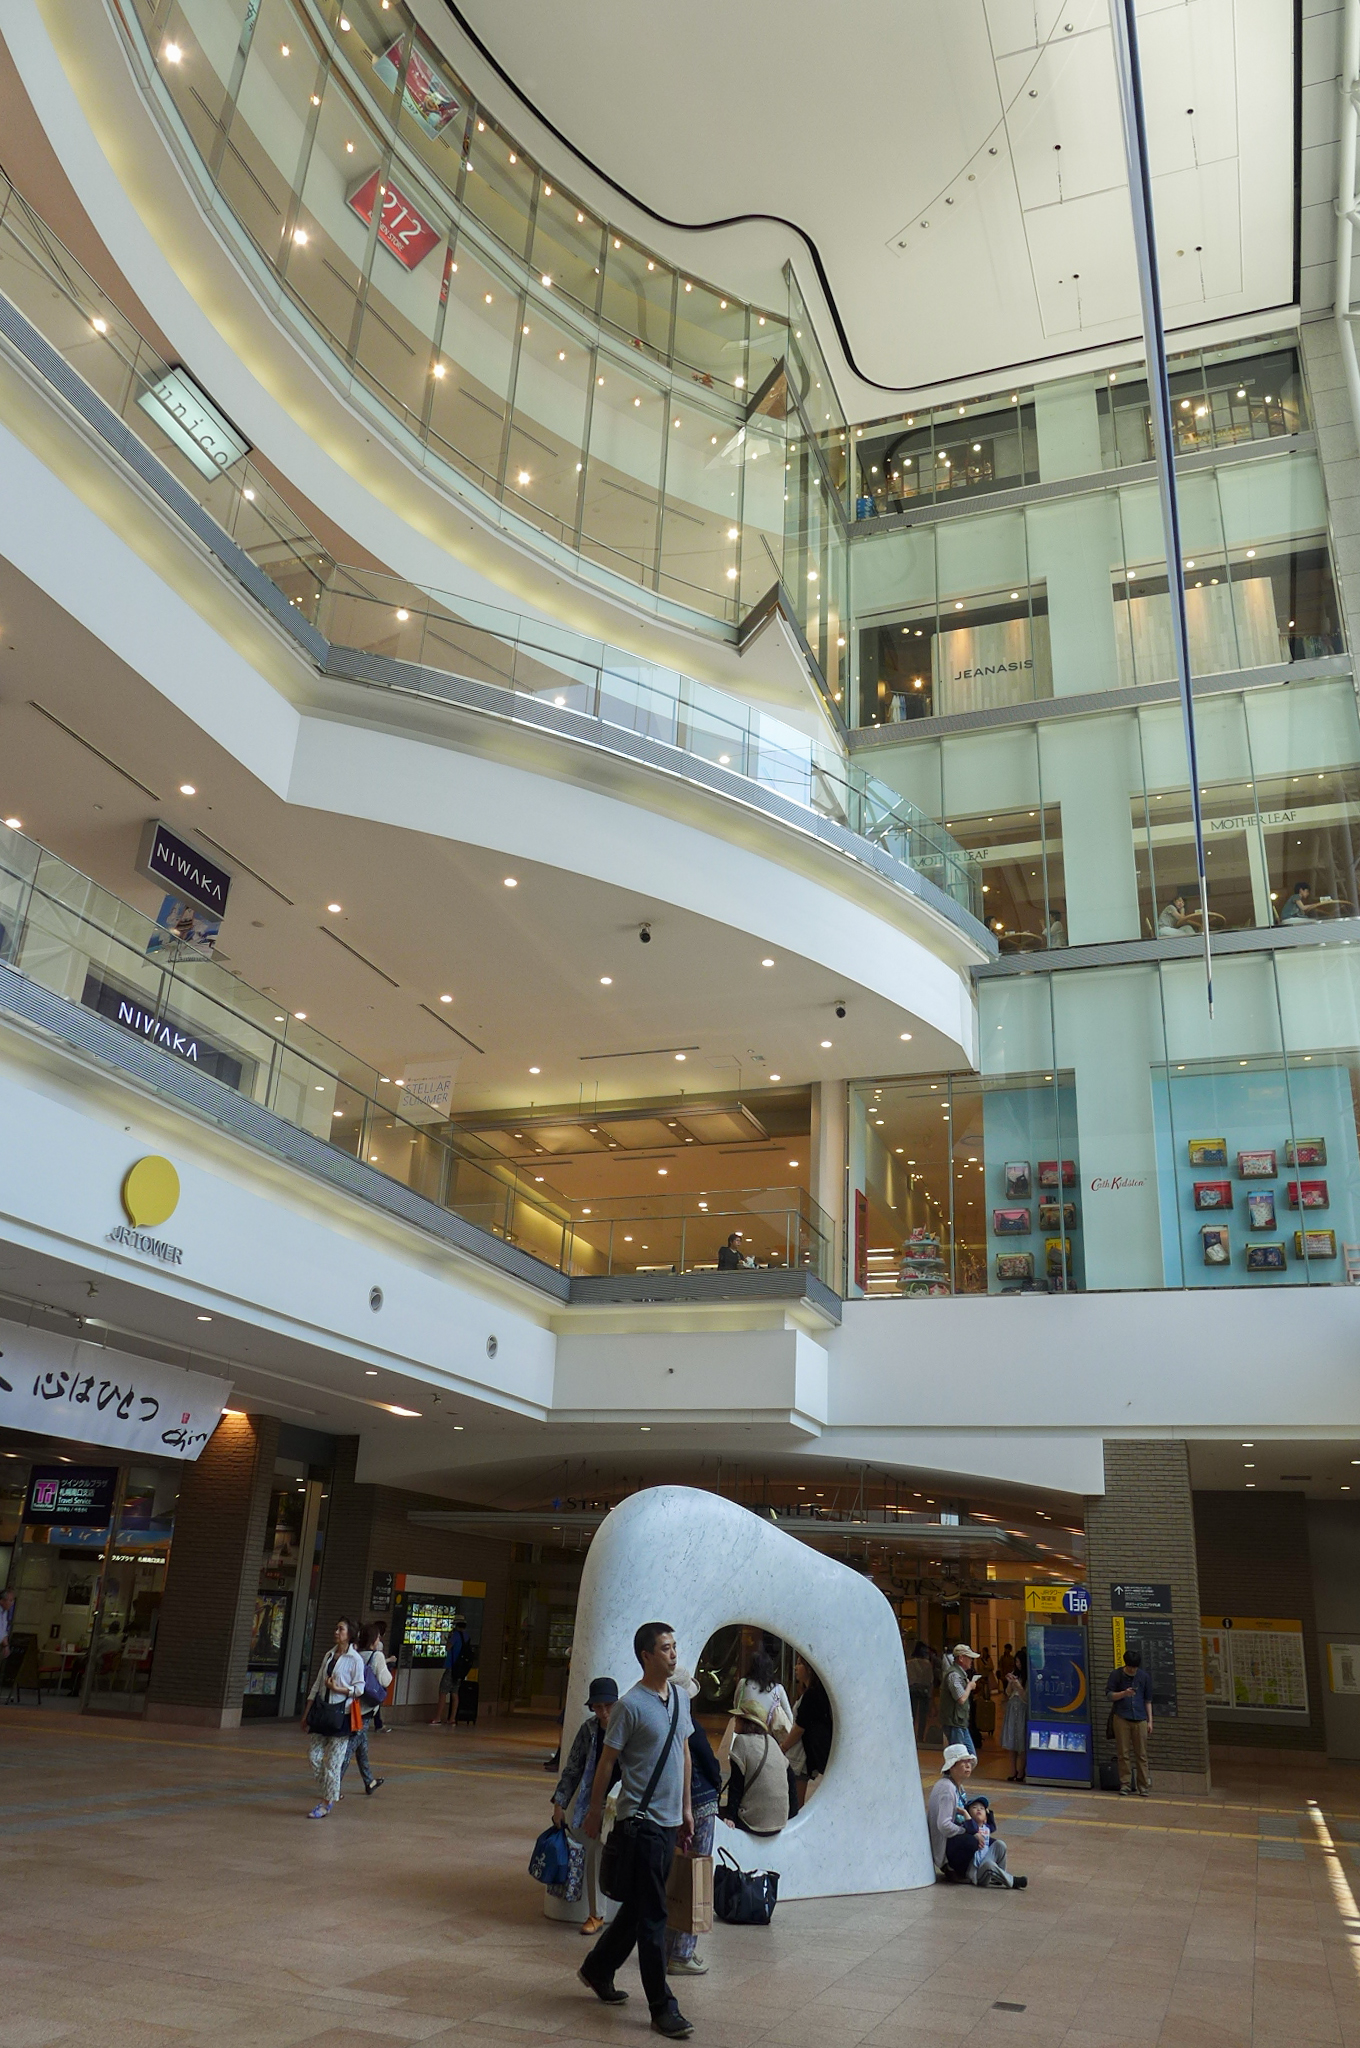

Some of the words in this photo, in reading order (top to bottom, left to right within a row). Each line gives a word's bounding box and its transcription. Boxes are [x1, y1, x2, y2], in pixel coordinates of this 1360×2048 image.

[387, 231, 405, 251] STORE
[157, 384, 228, 465] unico
[954, 659, 1034, 680] JEANASIS
[1210, 814, 1267, 831] MOTHER
[1268, 811, 1297, 824] LEAF
[963, 849, 989, 861] LEAF
[157, 842, 221, 900] NIWAKA
[405, 1080, 451, 1095] STELLAR
[402, 1093, 448, 1107] SUMMER
[1065, 1590, 1088, 1612] T38
